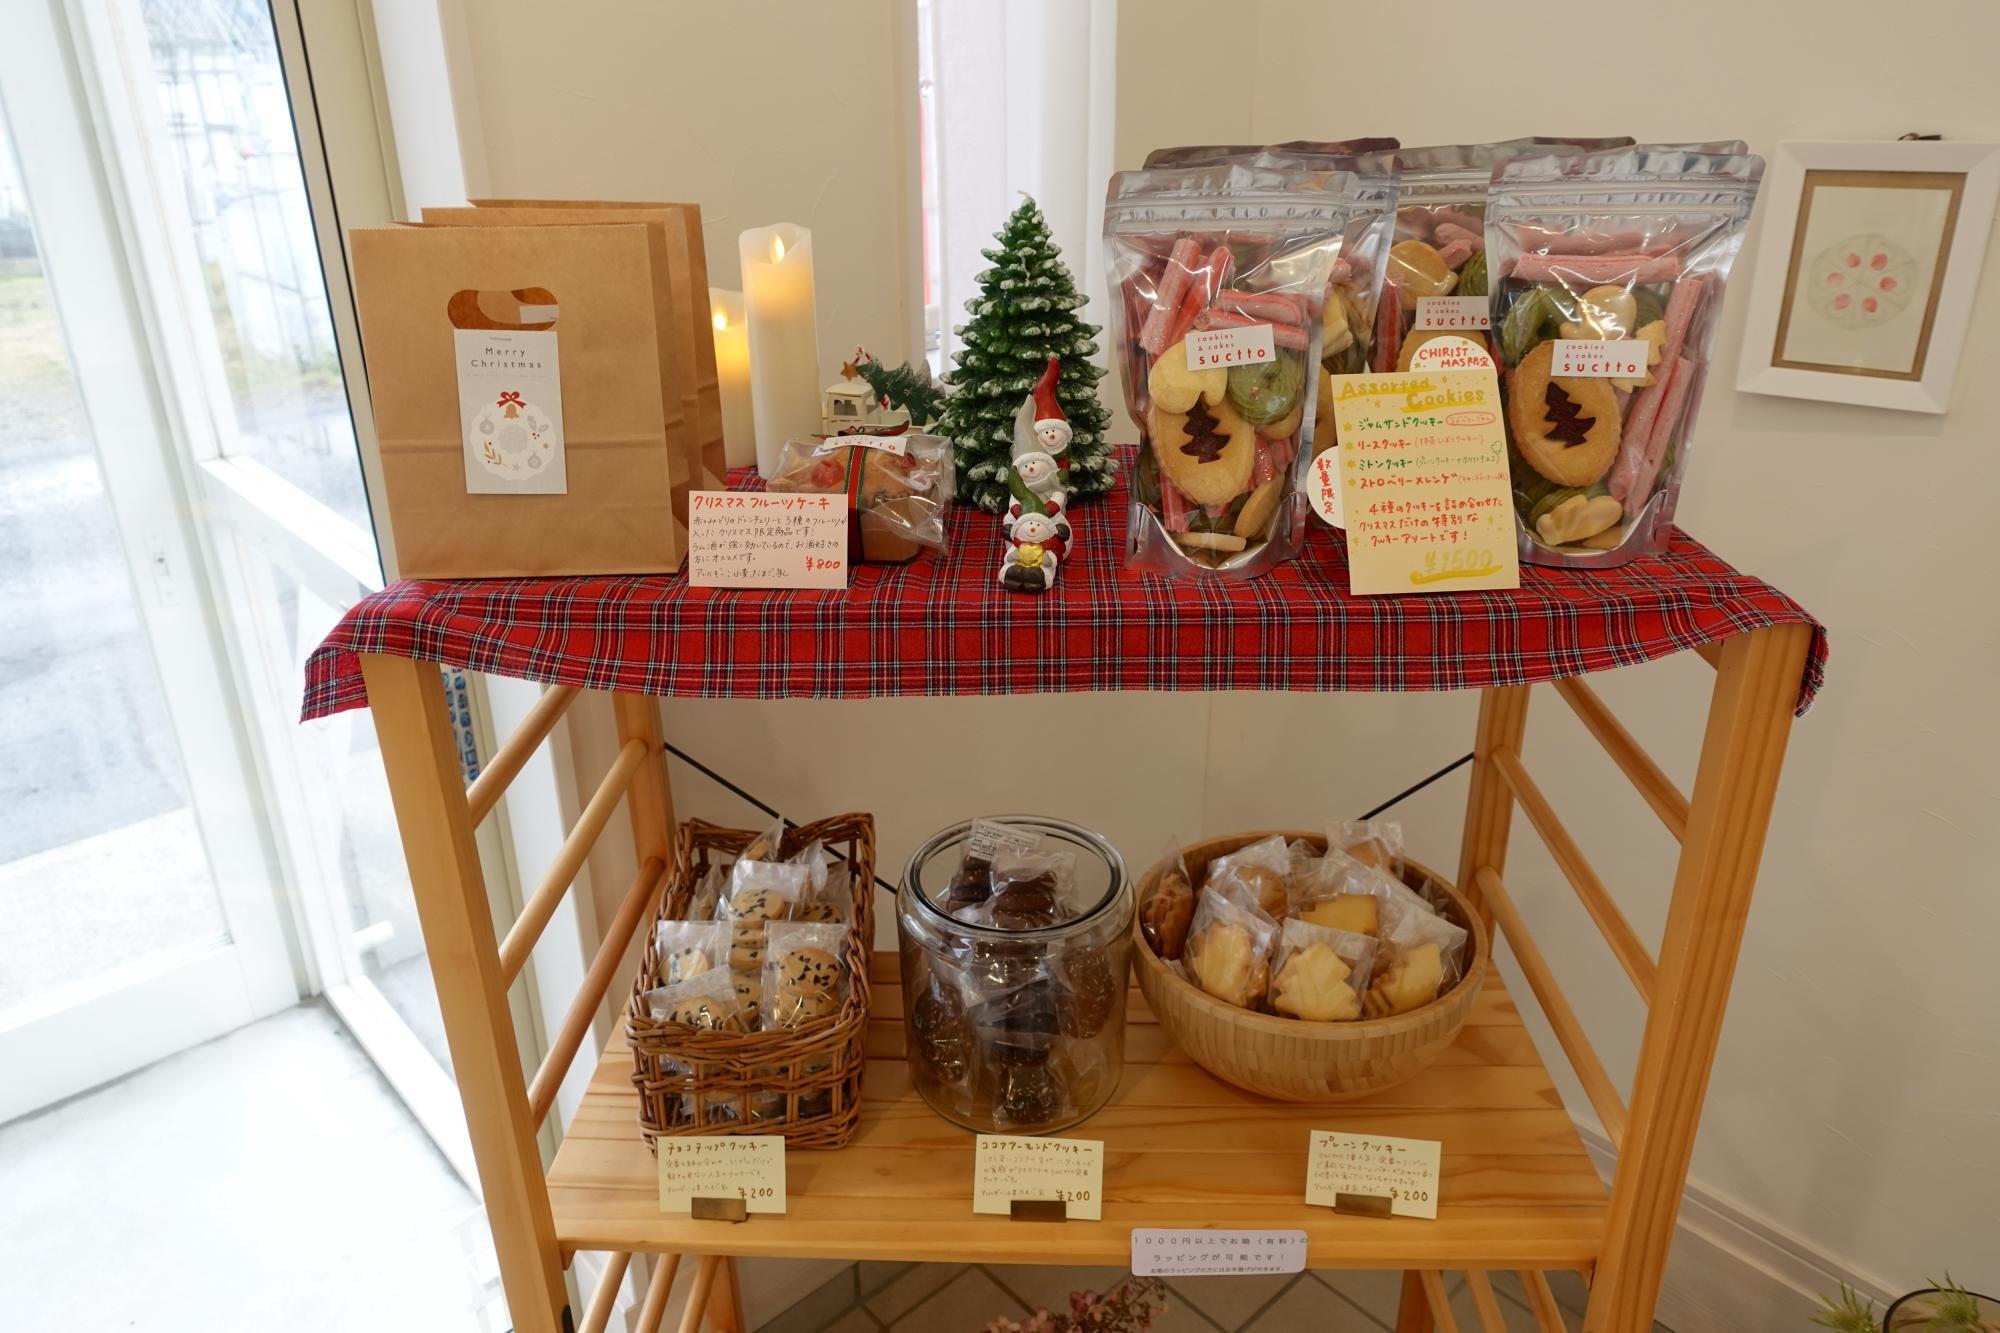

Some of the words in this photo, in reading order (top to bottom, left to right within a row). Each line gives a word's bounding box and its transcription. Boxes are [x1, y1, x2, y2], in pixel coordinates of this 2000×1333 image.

[1425, 315, 1489, 326] suctto
[1197, 333, 1234, 343] cookies
[485, 347, 525, 359] Merry
[1199, 348, 1266, 365] suctto
[1419, 347, 1471, 360] CHIRIST
[470, 359, 542, 369] Christmas
[1563, 361, 1636, 373] suctto
[1342, 377, 1430, 396] Assorted
[1405, 389, 1486, 409] Cookies
[1358, 416, 1444, 432] ジャムサンドクッキー
[1357, 438, 1412, 451] リースクッキー
[1358, 457, 1413, 471] ミトンクッキー
[1316, 457, 1335, 515] 数量限定
[1360, 472, 1458, 490] ストロベリーメレンゲ
[805, 555, 841, 572] ¥800
[1424, 550, 1494, 573] ¥1500
[1319, 1135, 1407, 1154] プレーンクッキー
[738, 1186, 773, 1200] ¥200
[1055, 1189, 1091, 1202] ¥200
[1390, 1186, 1429, 1202] ¥200
